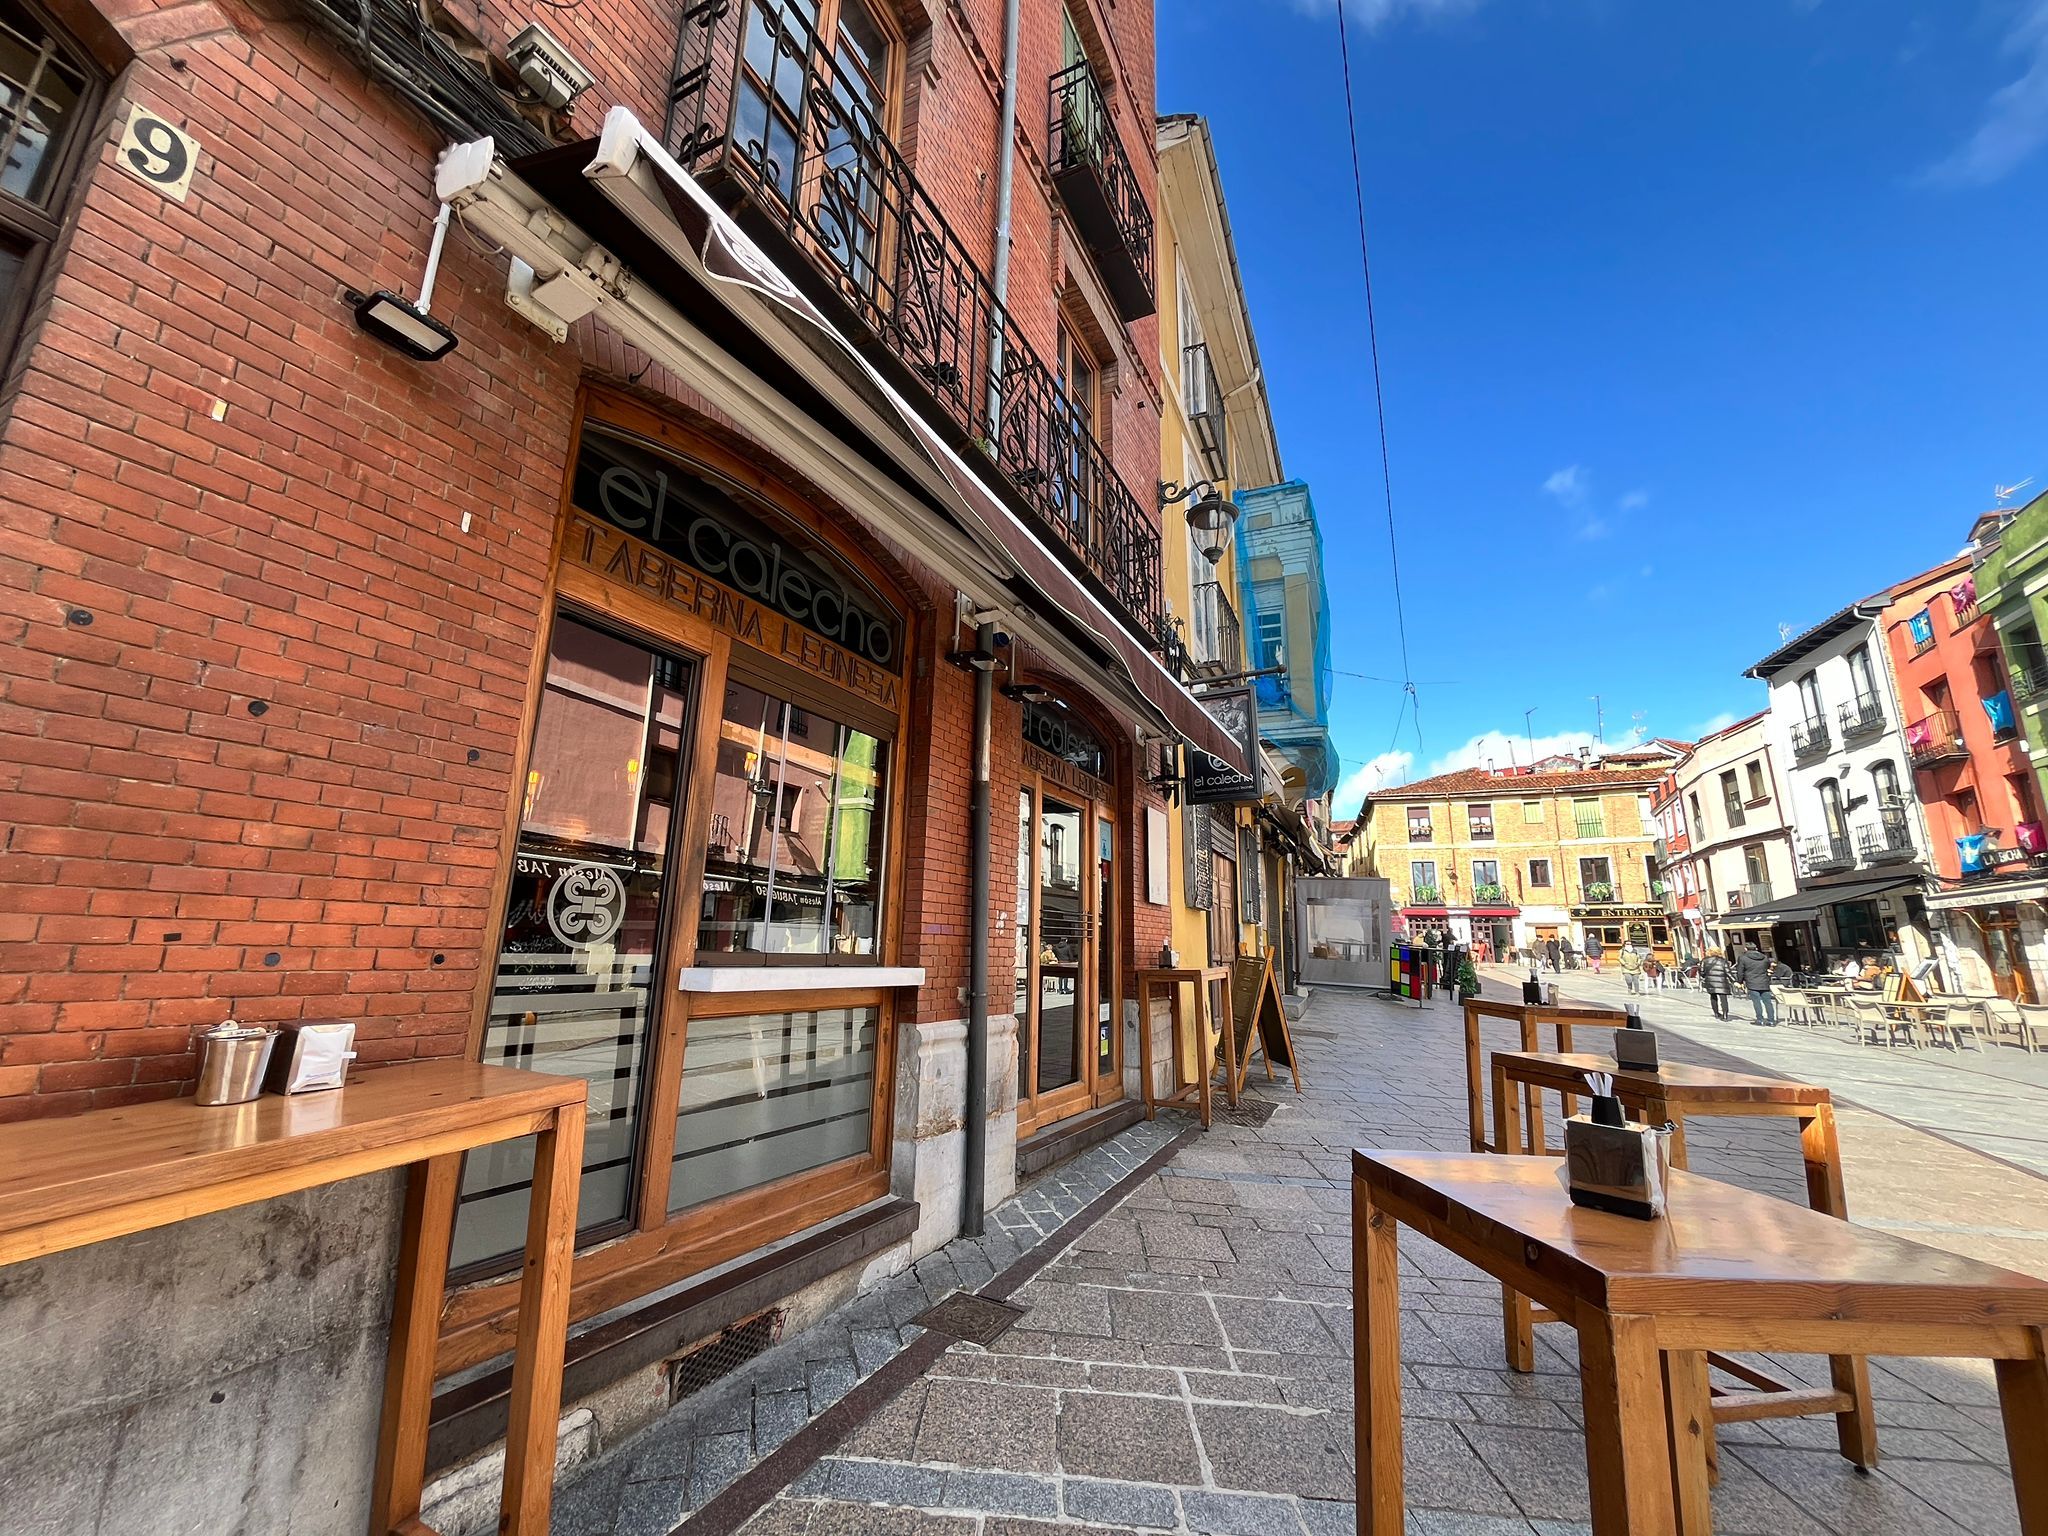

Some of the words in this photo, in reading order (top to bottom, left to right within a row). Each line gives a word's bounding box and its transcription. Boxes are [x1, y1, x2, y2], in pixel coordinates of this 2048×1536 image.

[127, 117, 188, 184] 9
[573, 517, 764, 646] TABERNA
[780, 622, 898, 710] LEONESA
[600, 466, 669, 541] el
[688, 516, 894, 664] calecho
[1194, 775, 1204, 787] el
